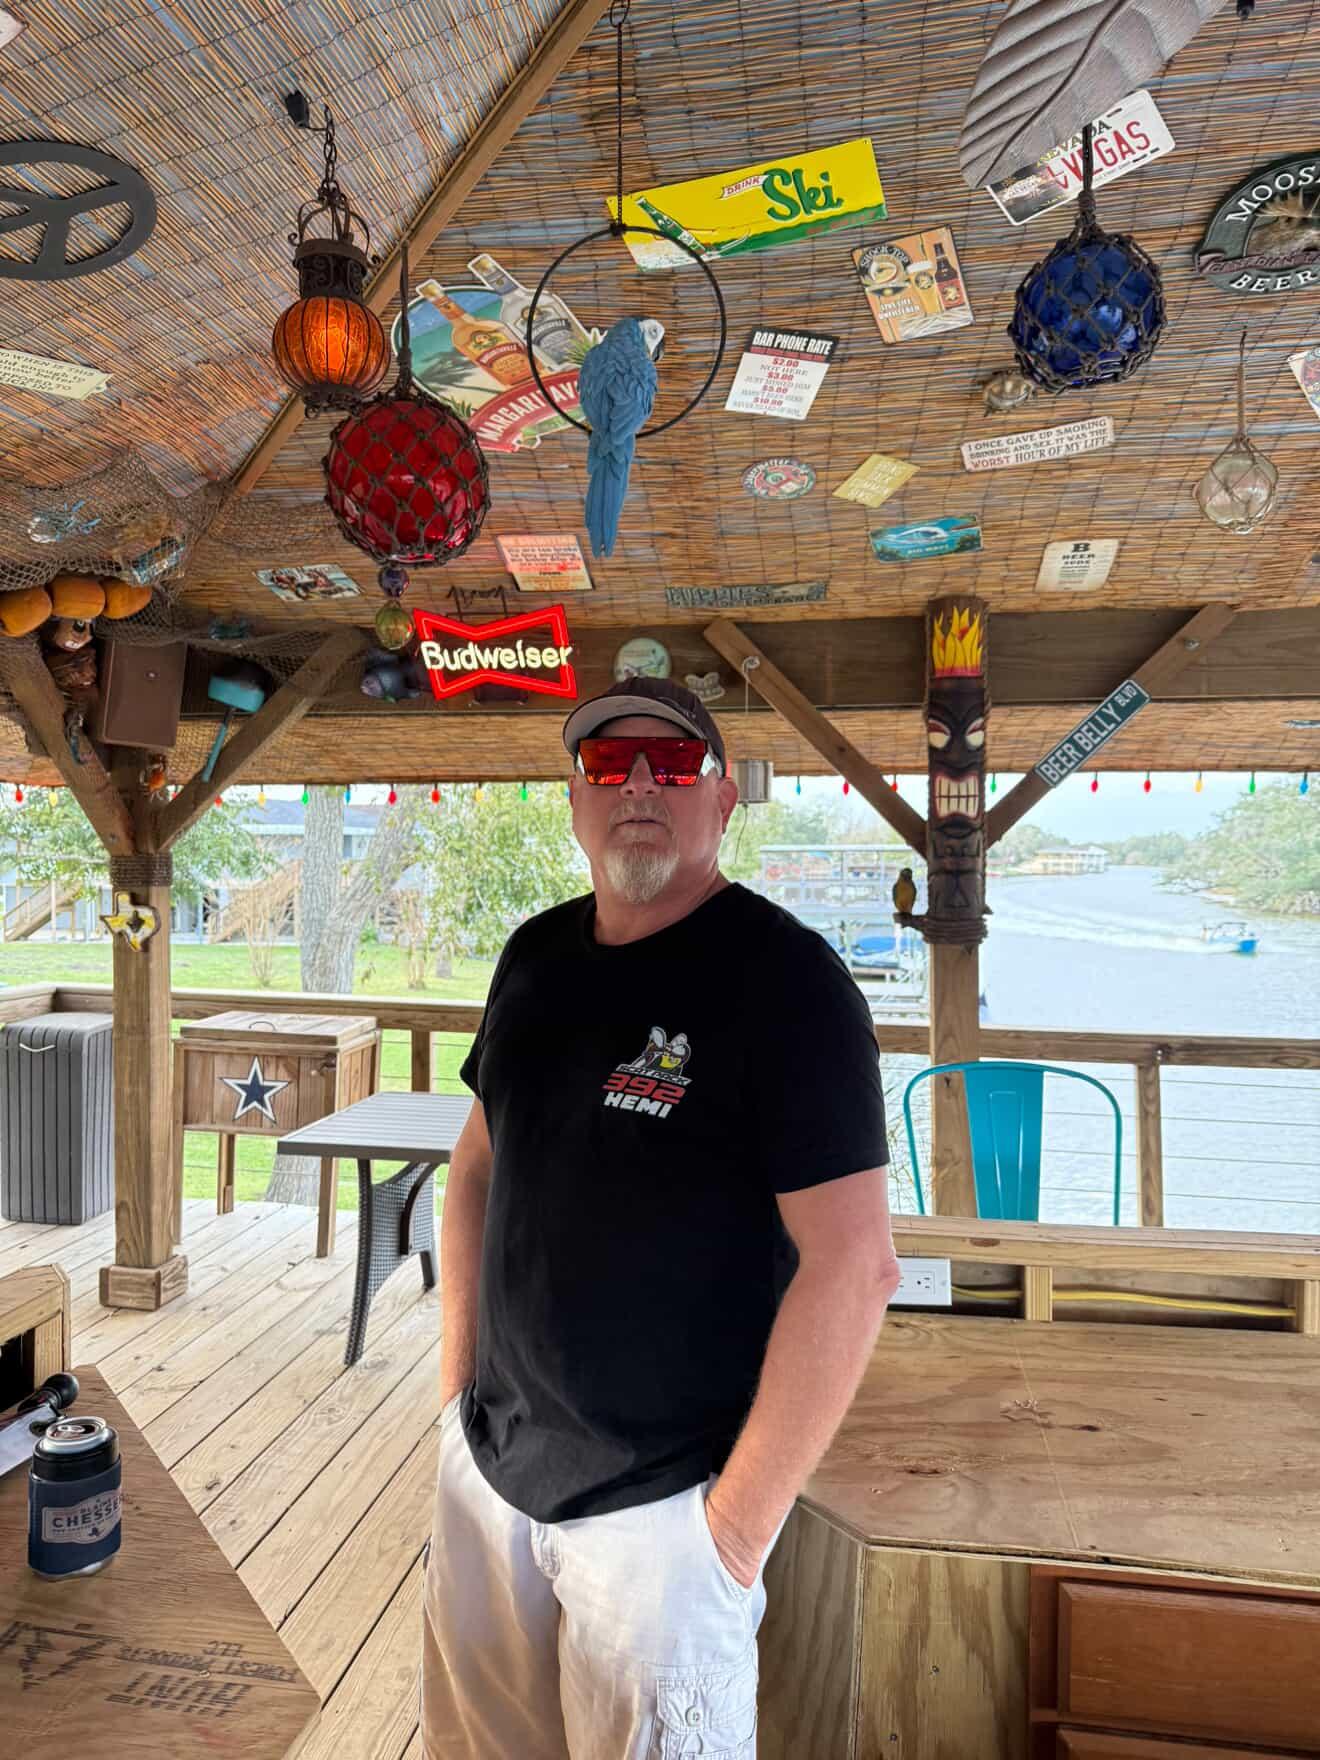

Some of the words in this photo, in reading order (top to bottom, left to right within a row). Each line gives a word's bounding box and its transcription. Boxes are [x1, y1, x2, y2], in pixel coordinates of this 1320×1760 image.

[726, 177, 762, 196] DRINK
[761, 167, 845, 222] Ski
[1225, 165, 1320, 222] MOOS
[1230, 270, 1318, 292] BEER
[752, 331, 775, 347] BAR
[773, 334, 808, 351] PHONE
[806, 338, 834, 355] RATE
[767, 371, 795, 381] $3.00
[772, 357, 800, 368] $2.00
[475, 380, 580, 441] MARGARIAV
[974, 440, 1003, 450] ONCE
[1006, 435, 1037, 445] GAVE
[1039, 431, 1054, 440] UP
[1055, 418, 1107, 436] SMOKING
[1014, 443, 1032, 453] AND
[1067, 433, 1087, 442] WAS
[1089, 428, 1108, 438] THE
[970, 455, 1011, 469] WORST
[1014, 449, 1047, 463] HOUR
[1048, 446, 1063, 457] OF
[1064, 441, 1082, 454] MY
[1084, 435, 1109, 449] LIFE
[1072, 542, 1091, 552] B
[420, 639, 573, 671] Budweiser
[1040, 743, 1083, 781] BEER
[1073, 703, 1122, 752] BELLY
[1113, 684, 1138, 707] BLVD
[603, 1073, 686, 1104] 392
[604, 1091, 673, 1119] HEMI
[53, 1499, 120, 1529] CHESSE
